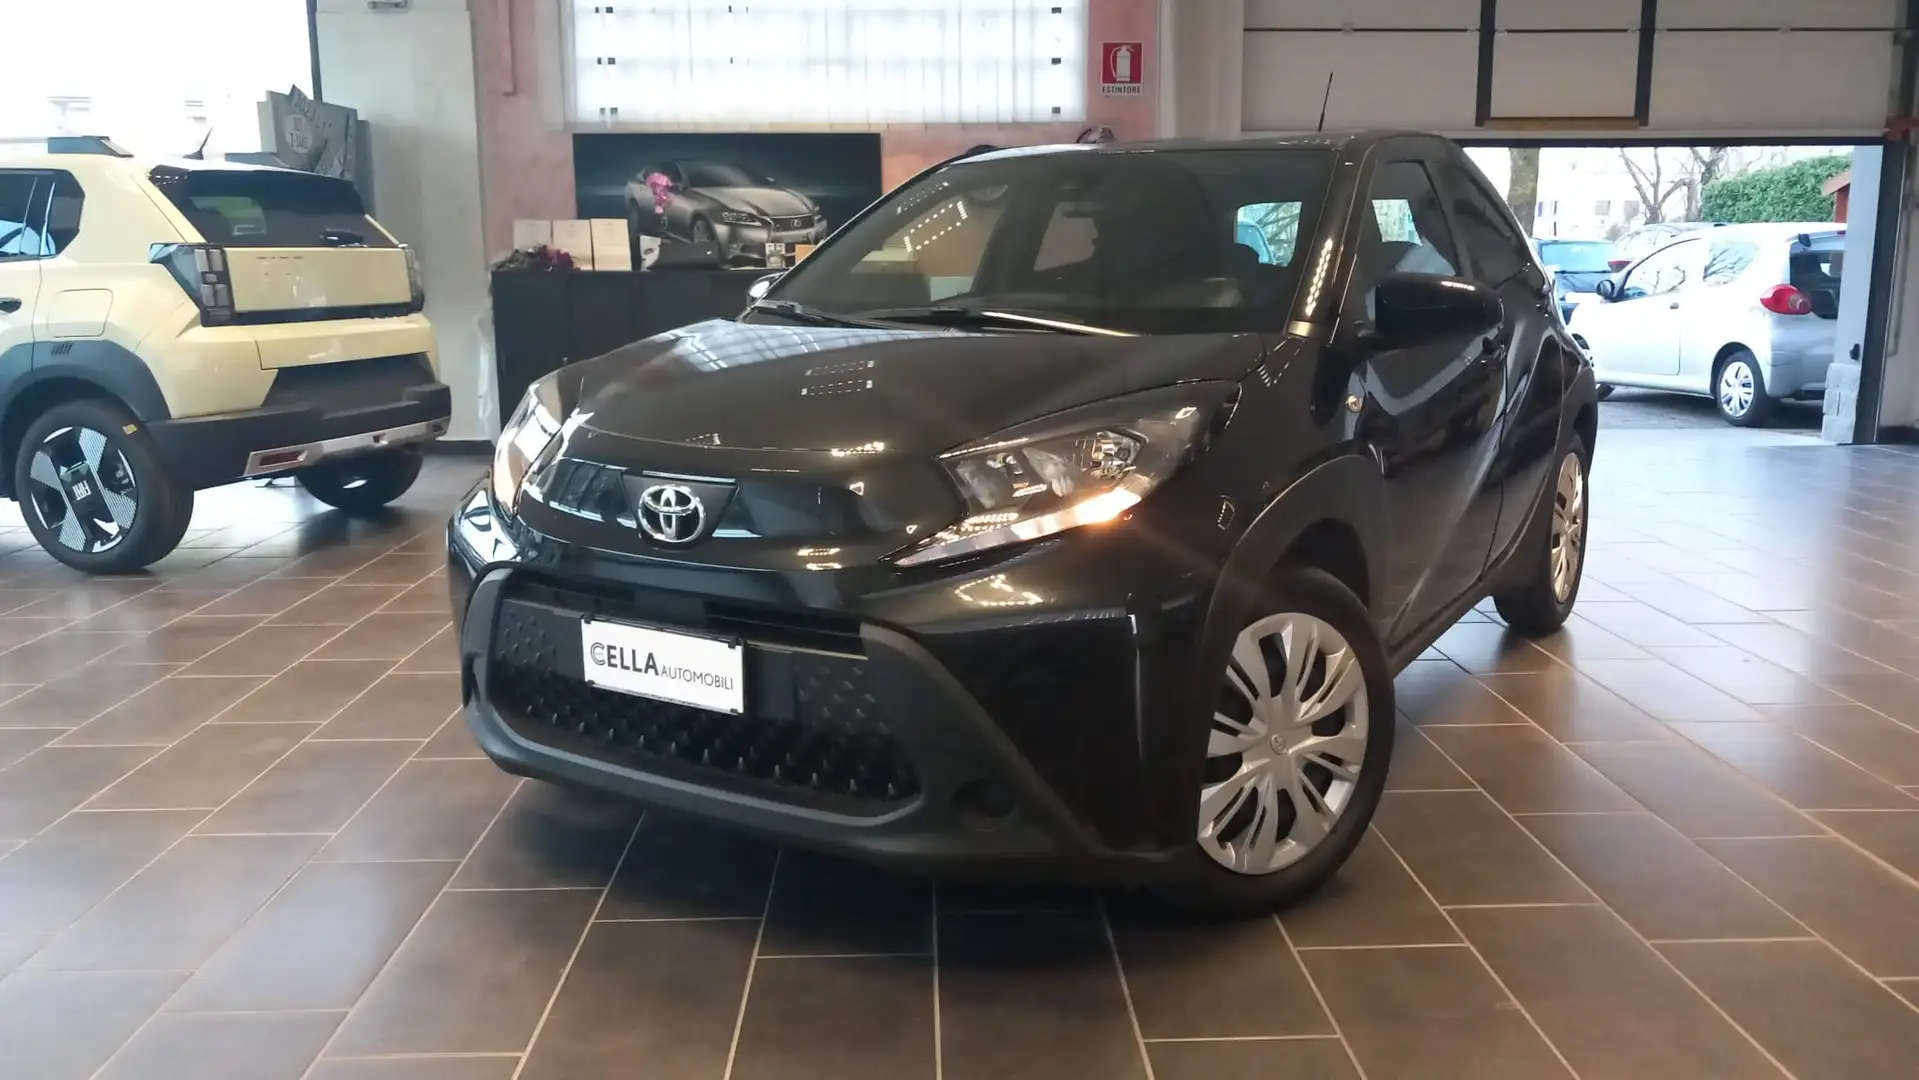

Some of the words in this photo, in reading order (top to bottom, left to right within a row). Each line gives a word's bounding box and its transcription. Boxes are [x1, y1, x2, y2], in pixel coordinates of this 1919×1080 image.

[1102, 85, 1140, 94] ESTINTORE
[590, 642, 659, 676] CELLA
[660, 665, 734, 691] AUTOMOBILI
